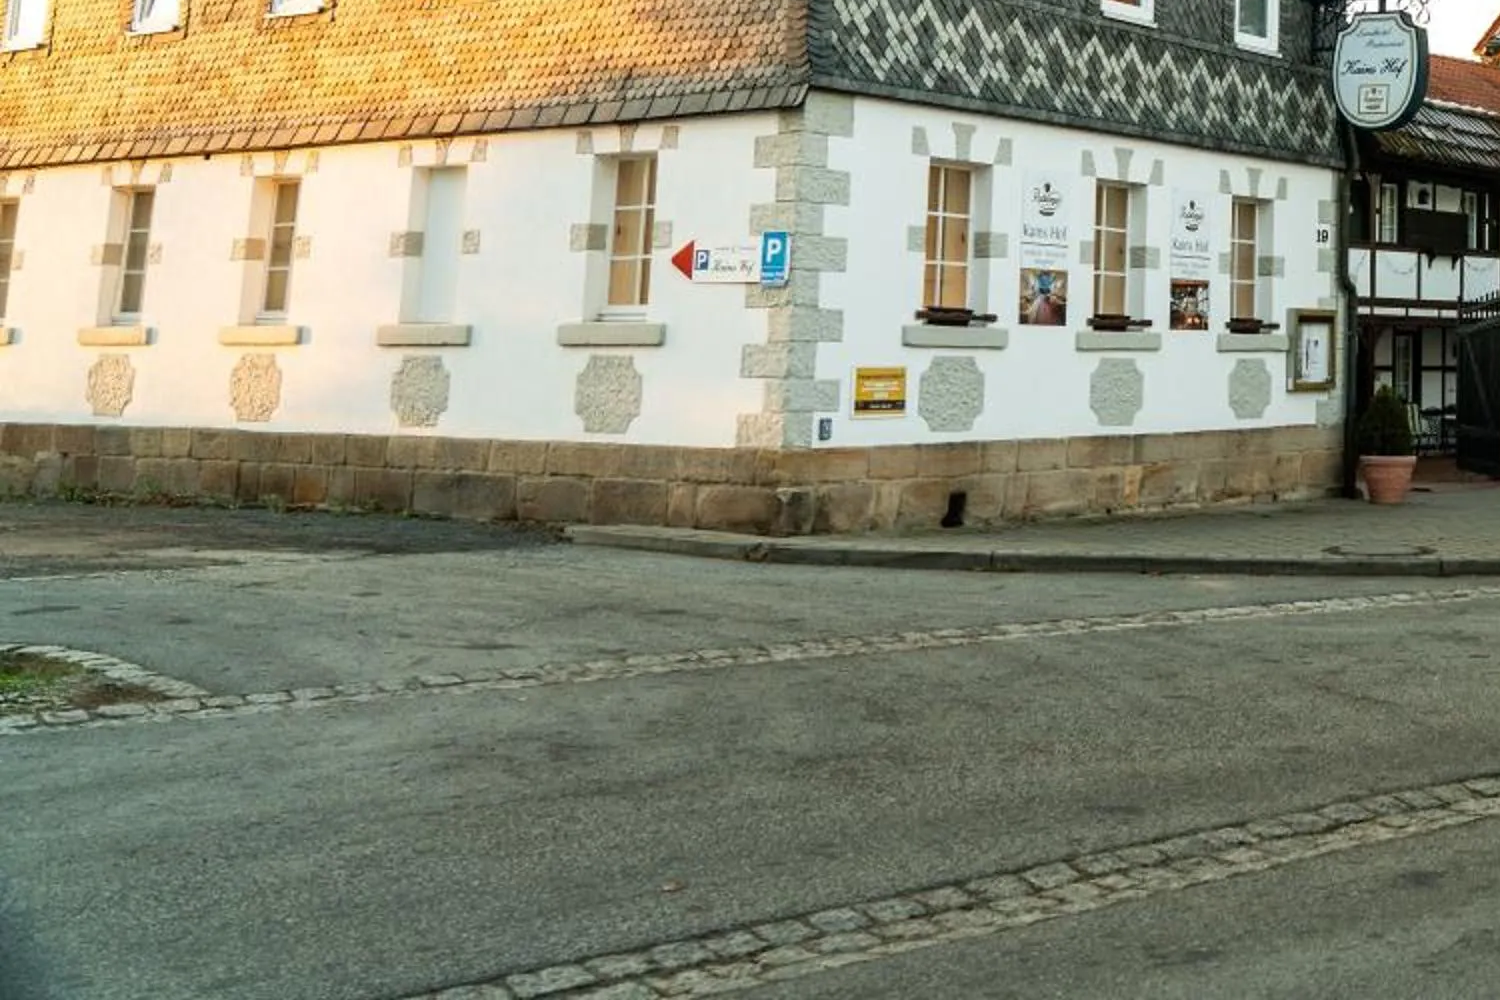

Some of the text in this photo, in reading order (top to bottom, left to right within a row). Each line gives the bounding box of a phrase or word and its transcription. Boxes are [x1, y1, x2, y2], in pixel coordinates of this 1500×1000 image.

[1380, 57, 1408, 79] Hof
[697, 251, 707, 269] P
[766, 238, 781, 263] P
